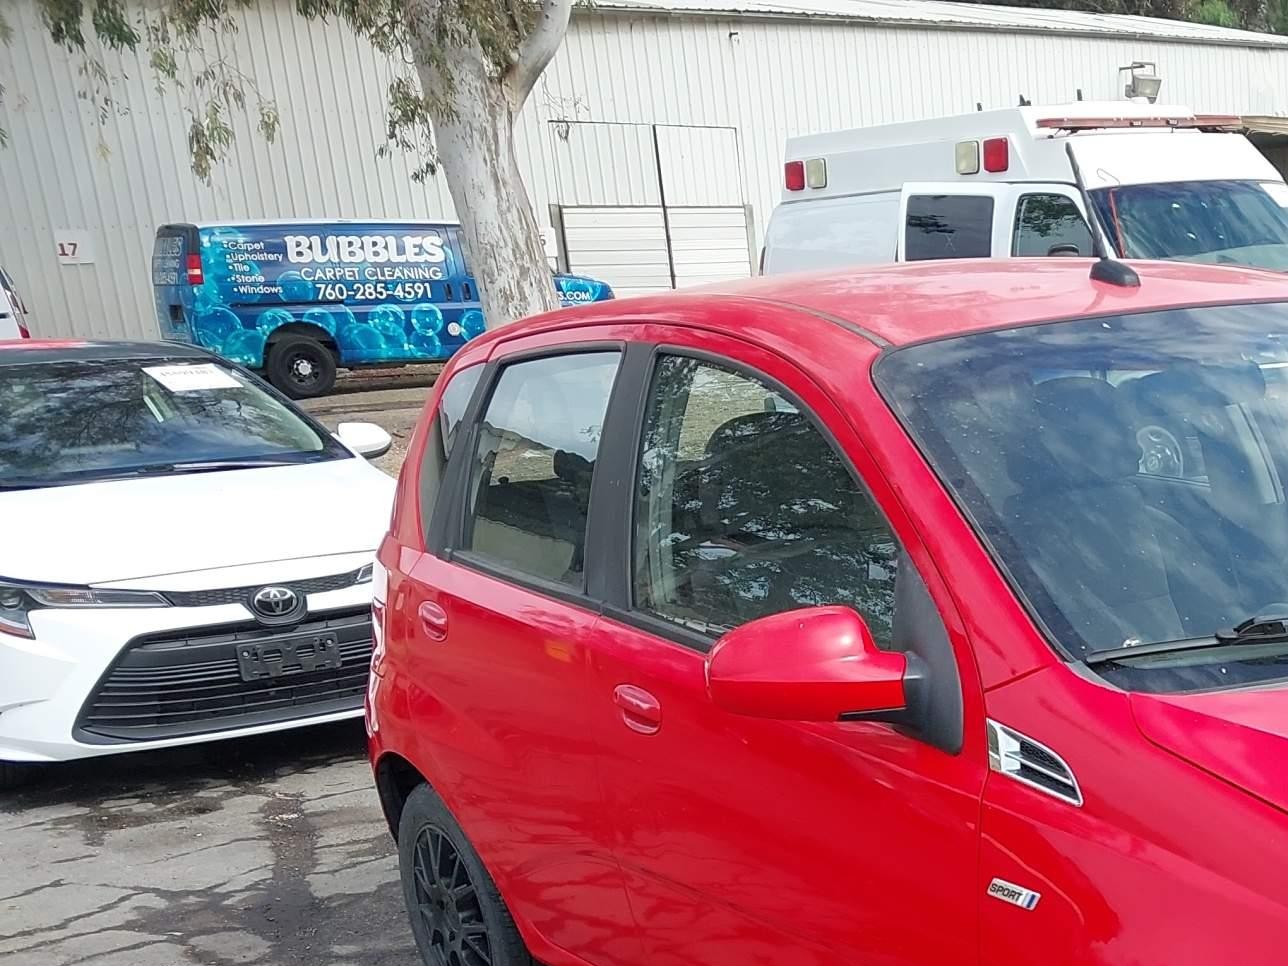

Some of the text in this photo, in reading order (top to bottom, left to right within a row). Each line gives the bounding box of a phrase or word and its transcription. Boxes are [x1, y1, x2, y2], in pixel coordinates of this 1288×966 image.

[58, 243, 78, 256] 17
[228, 241, 265, 251] Carpet
[284, 235, 445, 263] BUBBLES
[231, 252, 283, 262] Upholstery
[233, 263, 250, 272] Tile
[236, 274, 265, 283] Stone
[301, 266, 442, 281] CARPET CLEANING
[238, 285, 284, 294] Windows
[315, 283, 433, 300] 760-285-4591
[990, 884, 1023, 902] SPORT
